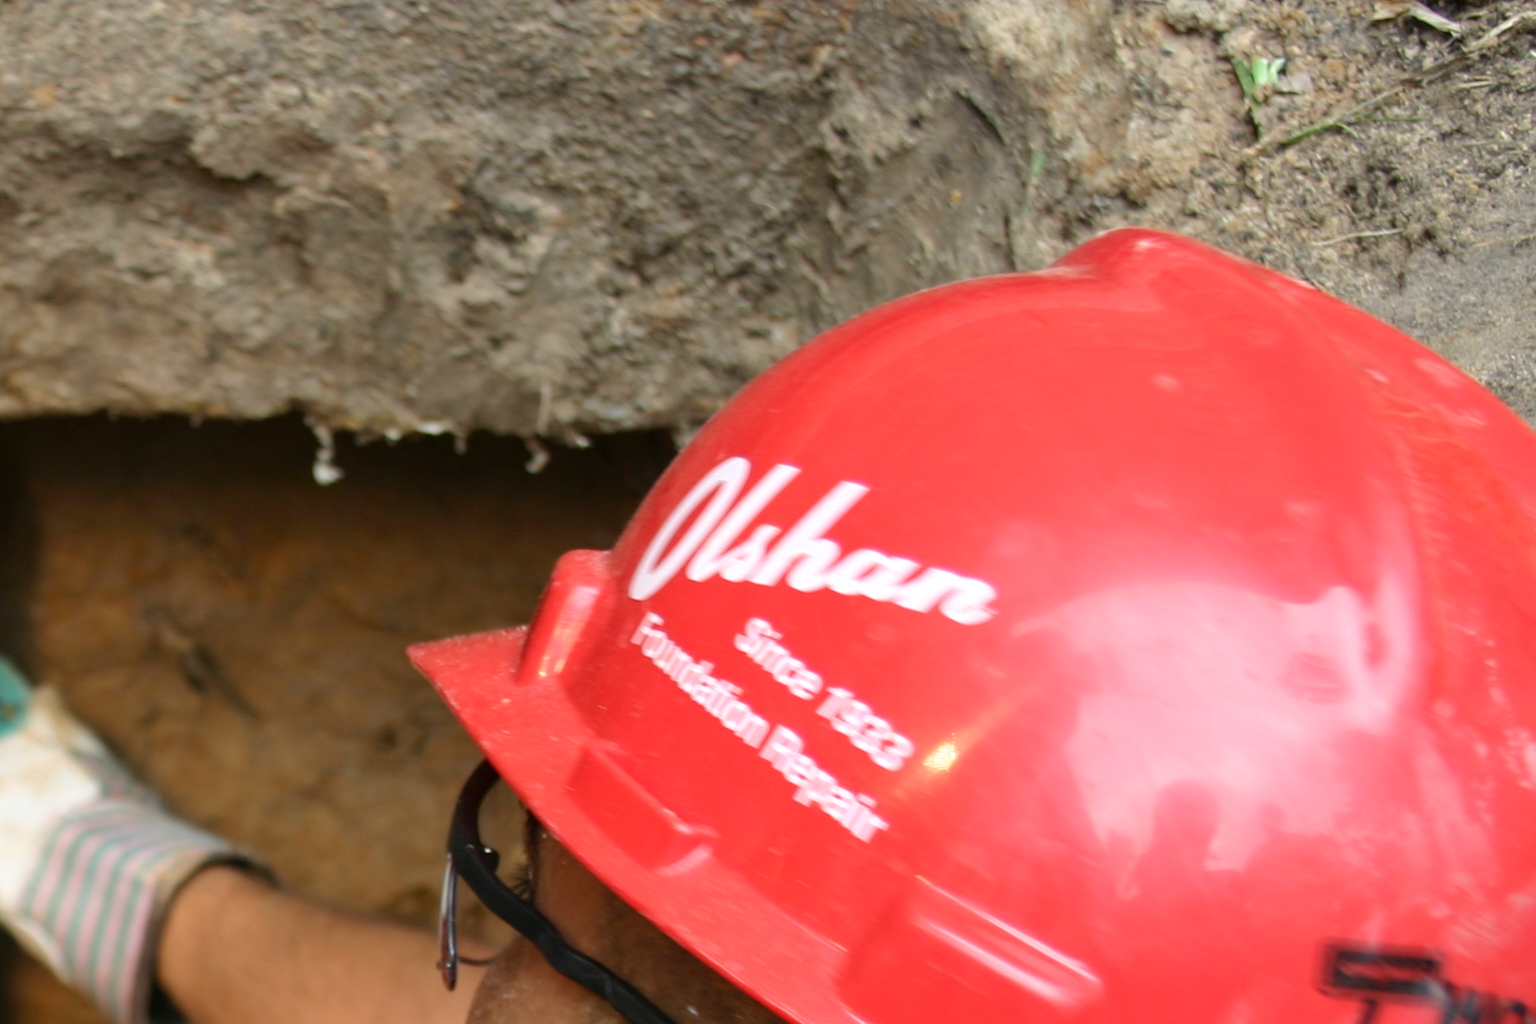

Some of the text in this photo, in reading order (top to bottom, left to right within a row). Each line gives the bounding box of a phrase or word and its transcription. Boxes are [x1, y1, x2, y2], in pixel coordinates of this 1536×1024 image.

[629, 457, 997, 625] Olshan
[631, 612, 889, 843] Foundation Repair
[735, 618, 823, 700] Since
